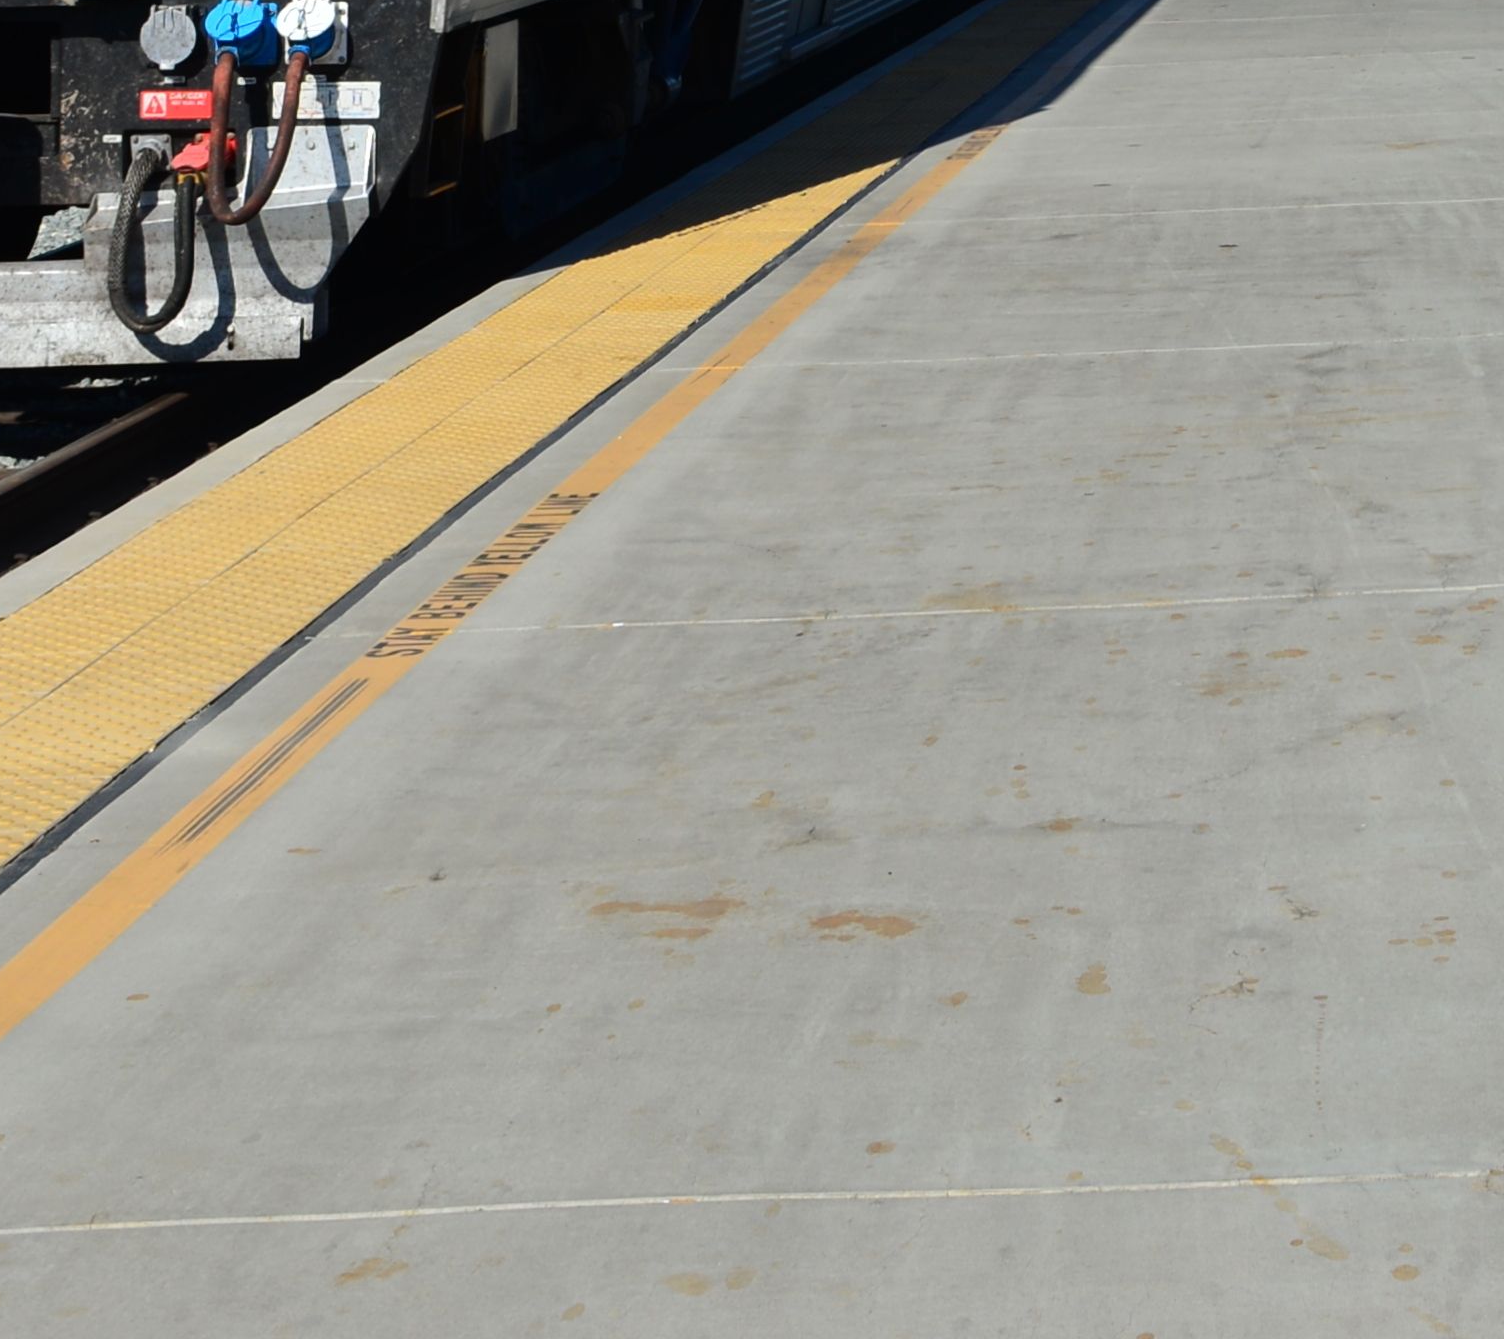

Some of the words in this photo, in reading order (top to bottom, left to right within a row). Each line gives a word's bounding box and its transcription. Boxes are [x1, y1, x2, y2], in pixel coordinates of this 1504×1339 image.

[527, 492, 600, 517] LINE
[467, 522, 567, 568] YELLOW
[407, 571, 510, 620] BEHIND
[365, 626, 451, 658] STAY
